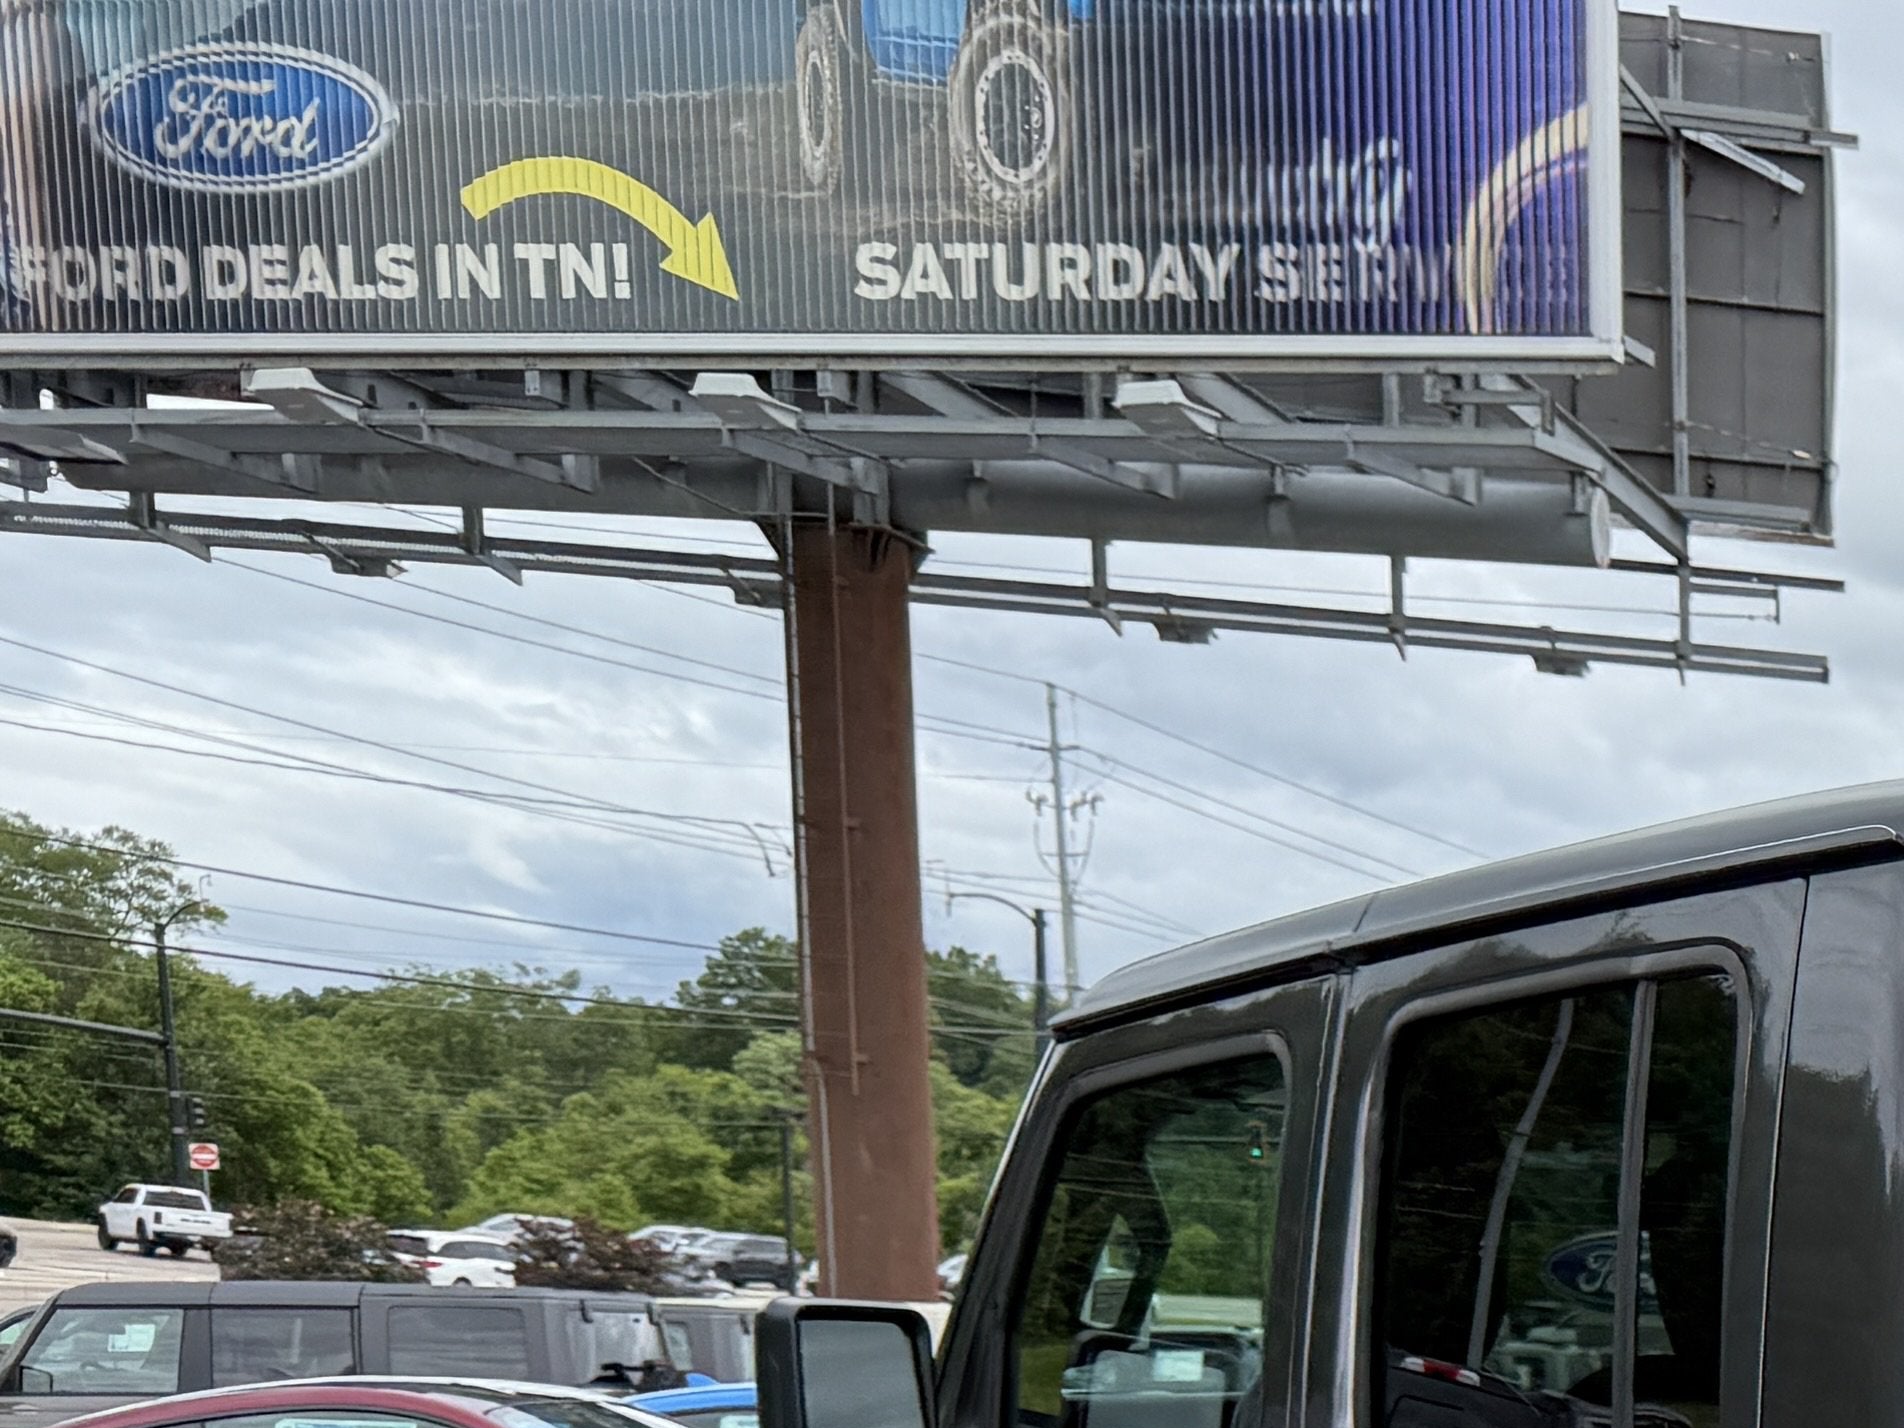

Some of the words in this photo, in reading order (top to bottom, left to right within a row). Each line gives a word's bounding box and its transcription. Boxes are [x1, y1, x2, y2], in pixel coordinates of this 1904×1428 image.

[154, 74, 321, 159] Ford
[20, 244, 190, 301] FORD
[202, 243, 417, 301] DEALS
[435, 242, 501, 300] IN
[513, 241, 632, 300] TN!
[853, 241, 1241, 302] SATURDAY
